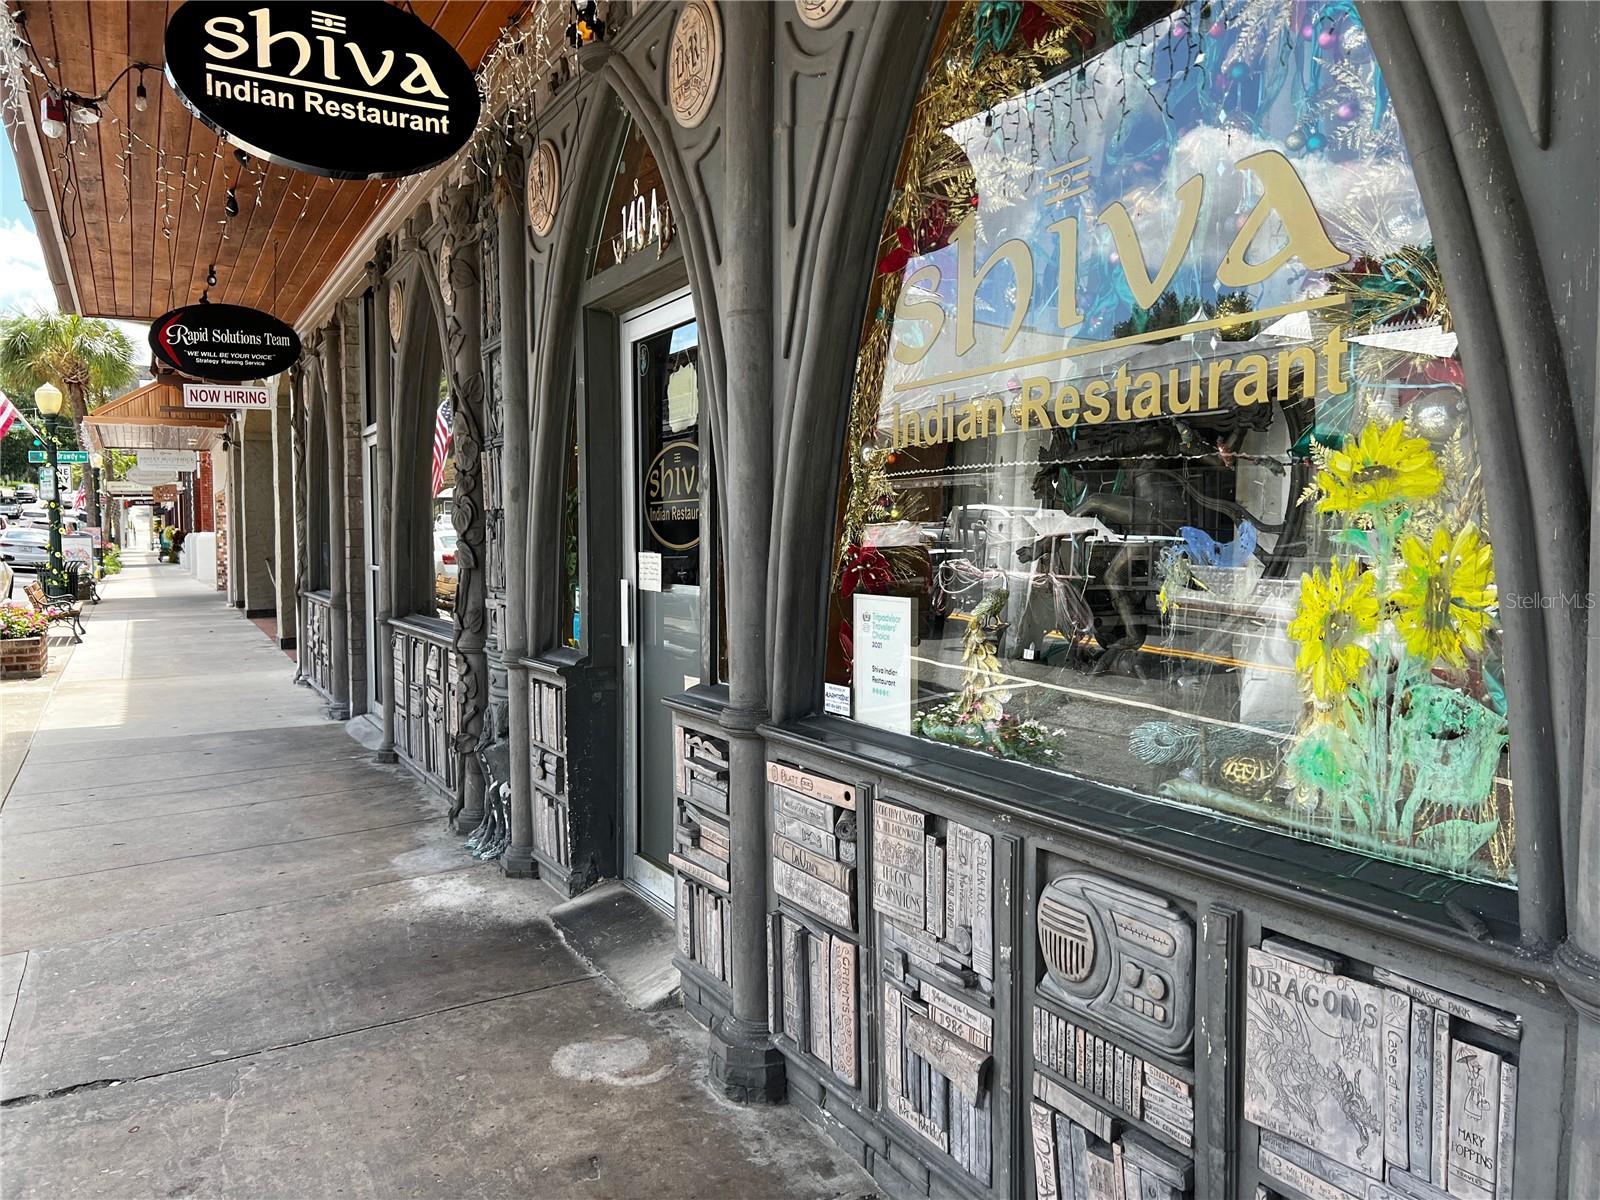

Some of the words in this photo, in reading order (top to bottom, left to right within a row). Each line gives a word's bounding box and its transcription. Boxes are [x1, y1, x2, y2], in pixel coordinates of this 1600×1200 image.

[205, 72, 295, 110] Indian
[304, 90, 450, 135] Restaurant
[165, 324, 208, 346] Rapid
[212, 329, 262, 346] Solutions
[264, 332, 290, 347] Team
[195, 357, 219, 365] Strategy
[221, 358, 244, 366] Planning
[189, 388, 221, 403] NOW
[224, 390, 267, 405] HIRING
[892, 392, 1005, 449] Indian
[1020, 326, 1349, 433] Restaurant
[650, 507, 671, 521] Indian
[671, 505, 699, 521] Restaur
[872, 675, 896, 687] Restaurant
[1336, 977, 1351, 991] OF
[1249, 964, 1379, 1029] DRAGONS
[1403, 984, 1445, 1006] JURASSIC
[1448, 1001, 1472, 1019] PARK
[939, 1013, 964, 1036] 1984
[1387, 1031, 1403, 1071] Casey
[1388, 1075, 1401, 1092] at
[1458, 1127, 1485, 1147] MARY
[1452, 1140, 1493, 1170] POPPINS
